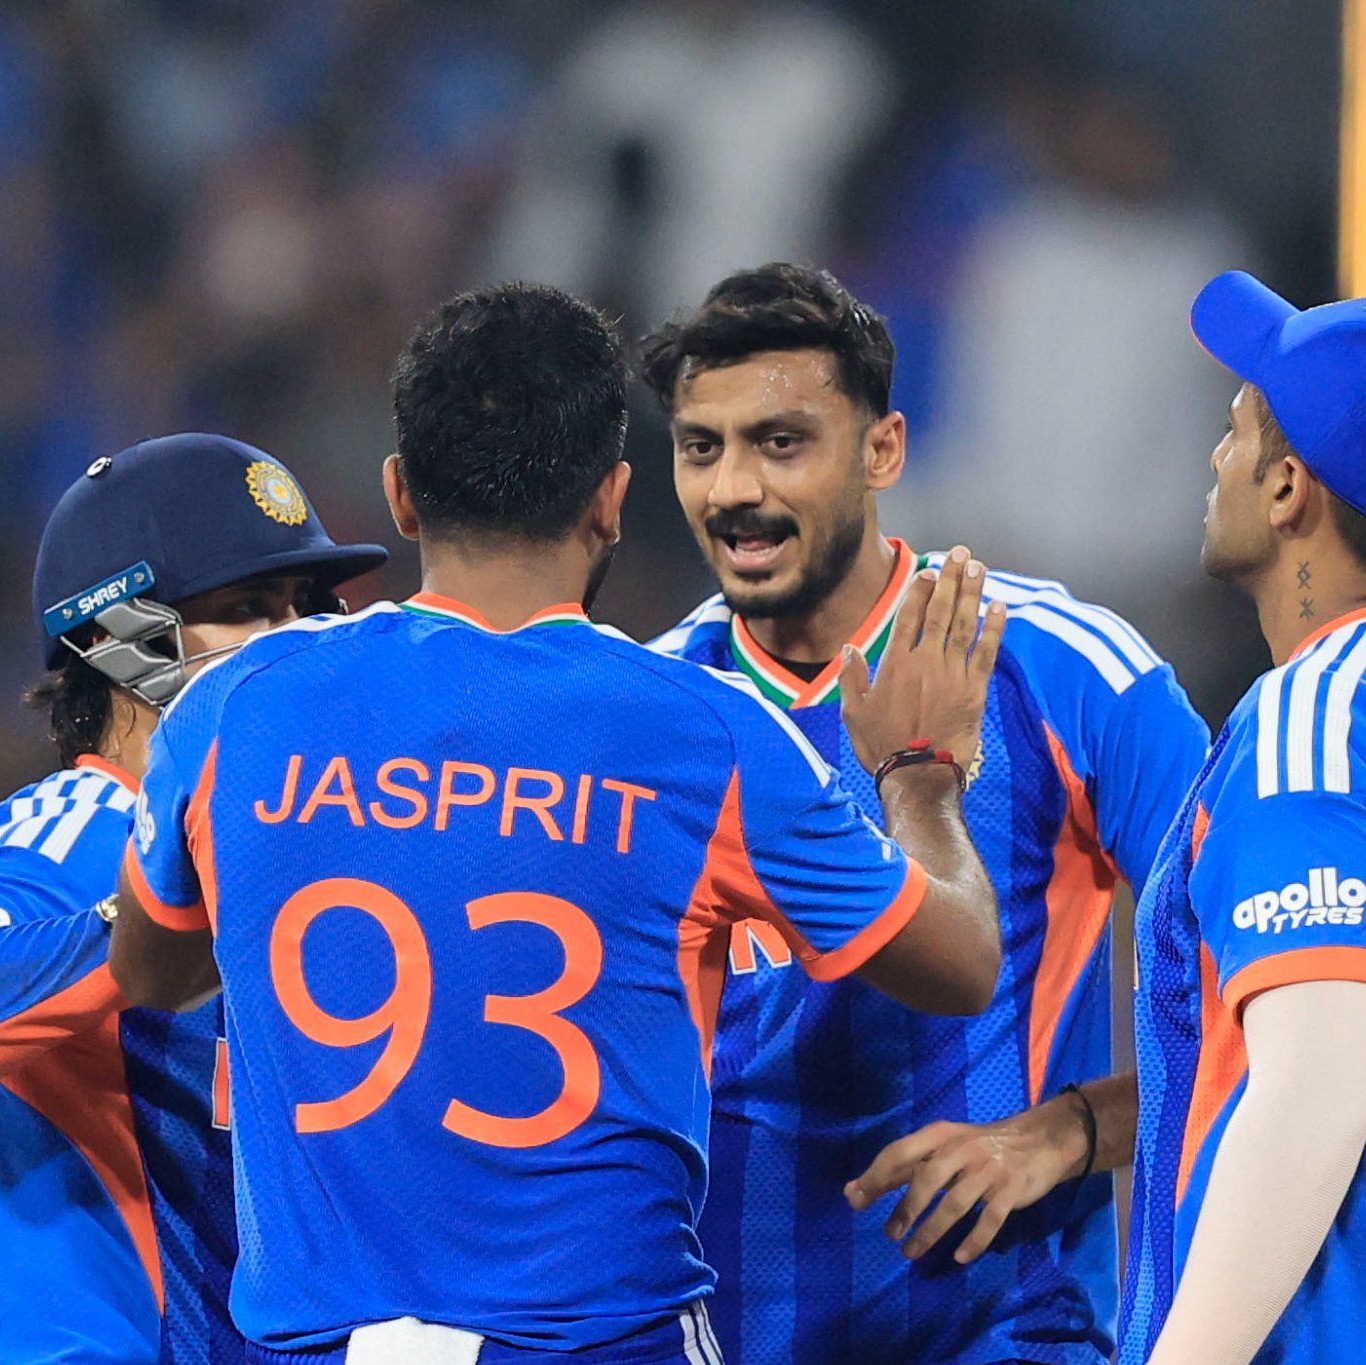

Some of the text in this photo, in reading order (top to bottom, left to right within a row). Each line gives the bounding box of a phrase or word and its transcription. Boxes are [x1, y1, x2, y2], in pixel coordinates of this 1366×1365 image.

[78, 576, 127, 616] SHREY
[254, 755, 657, 854] JASPRIT
[1272, 906, 1366, 935] TYRES
[269, 877, 604, 1149] 93
